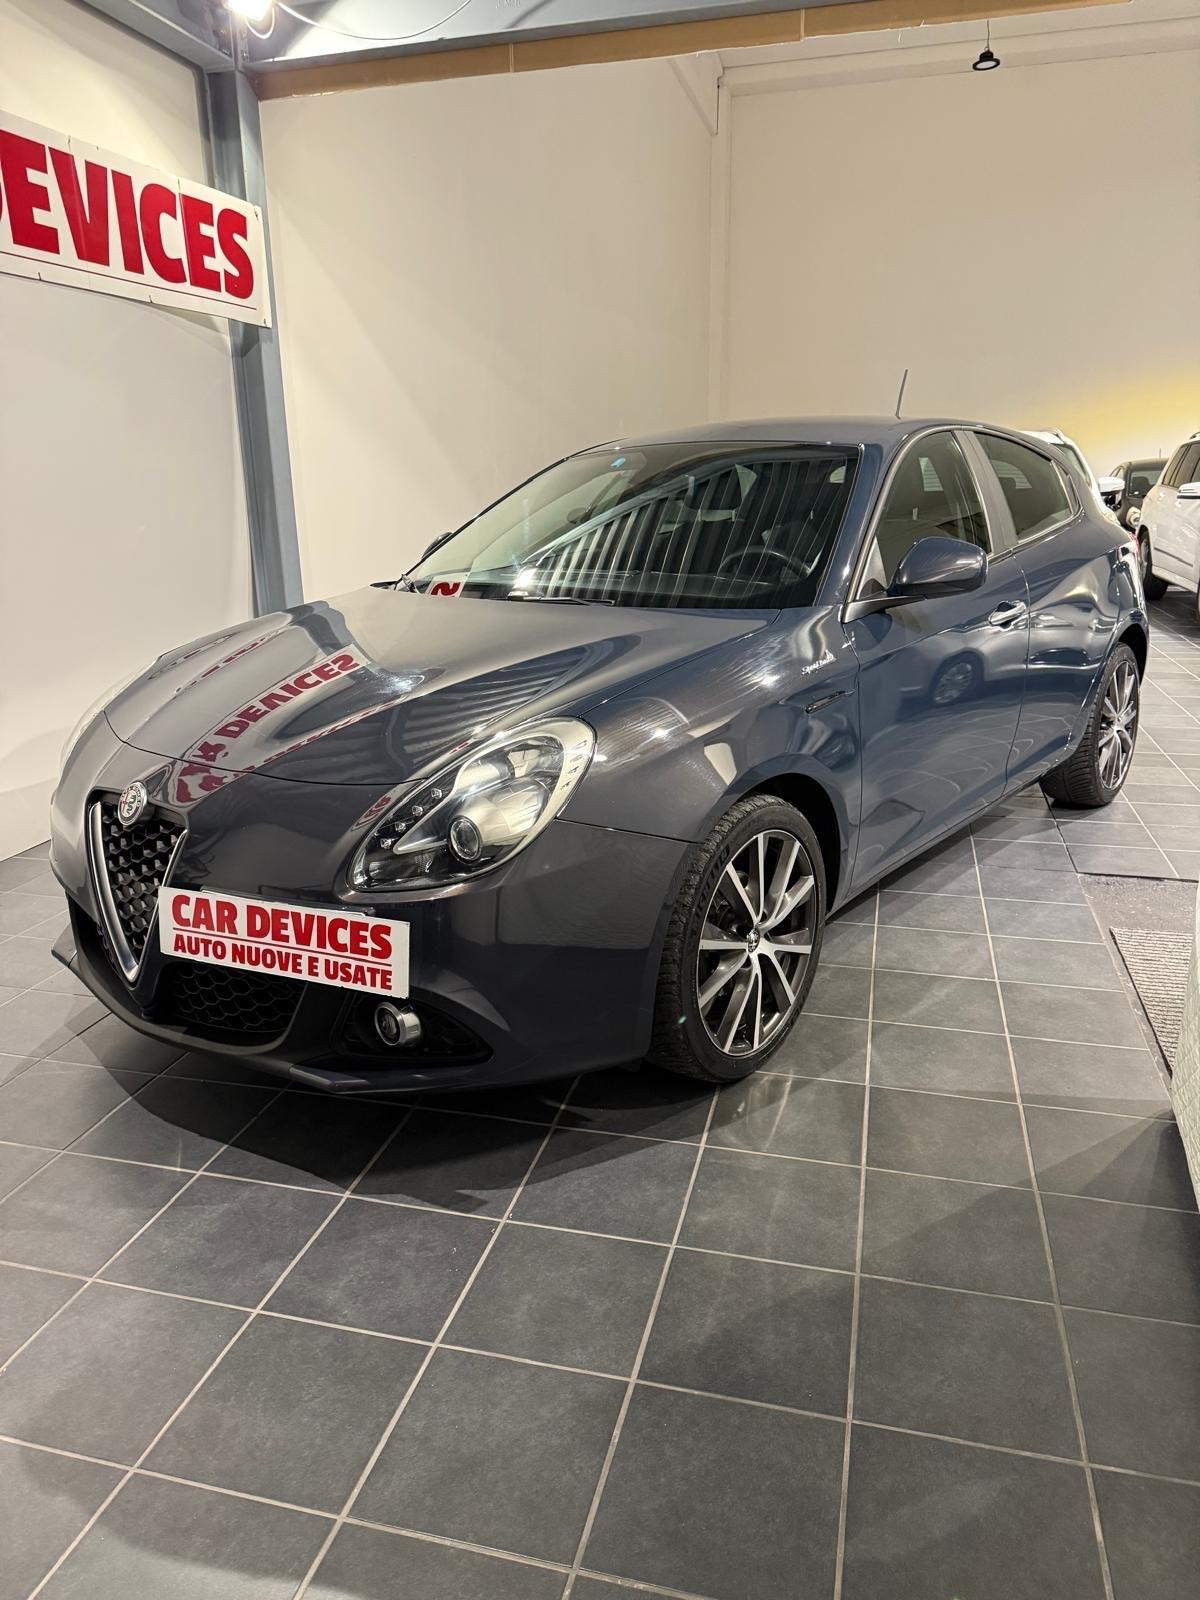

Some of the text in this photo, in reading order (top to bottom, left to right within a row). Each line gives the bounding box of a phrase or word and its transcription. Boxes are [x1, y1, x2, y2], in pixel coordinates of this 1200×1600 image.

[0, 129, 254, 300] EVICES
[171, 894, 392, 960] CAR DEVICES
[173, 934, 393, 991] AUTO NUOVE E USATE
